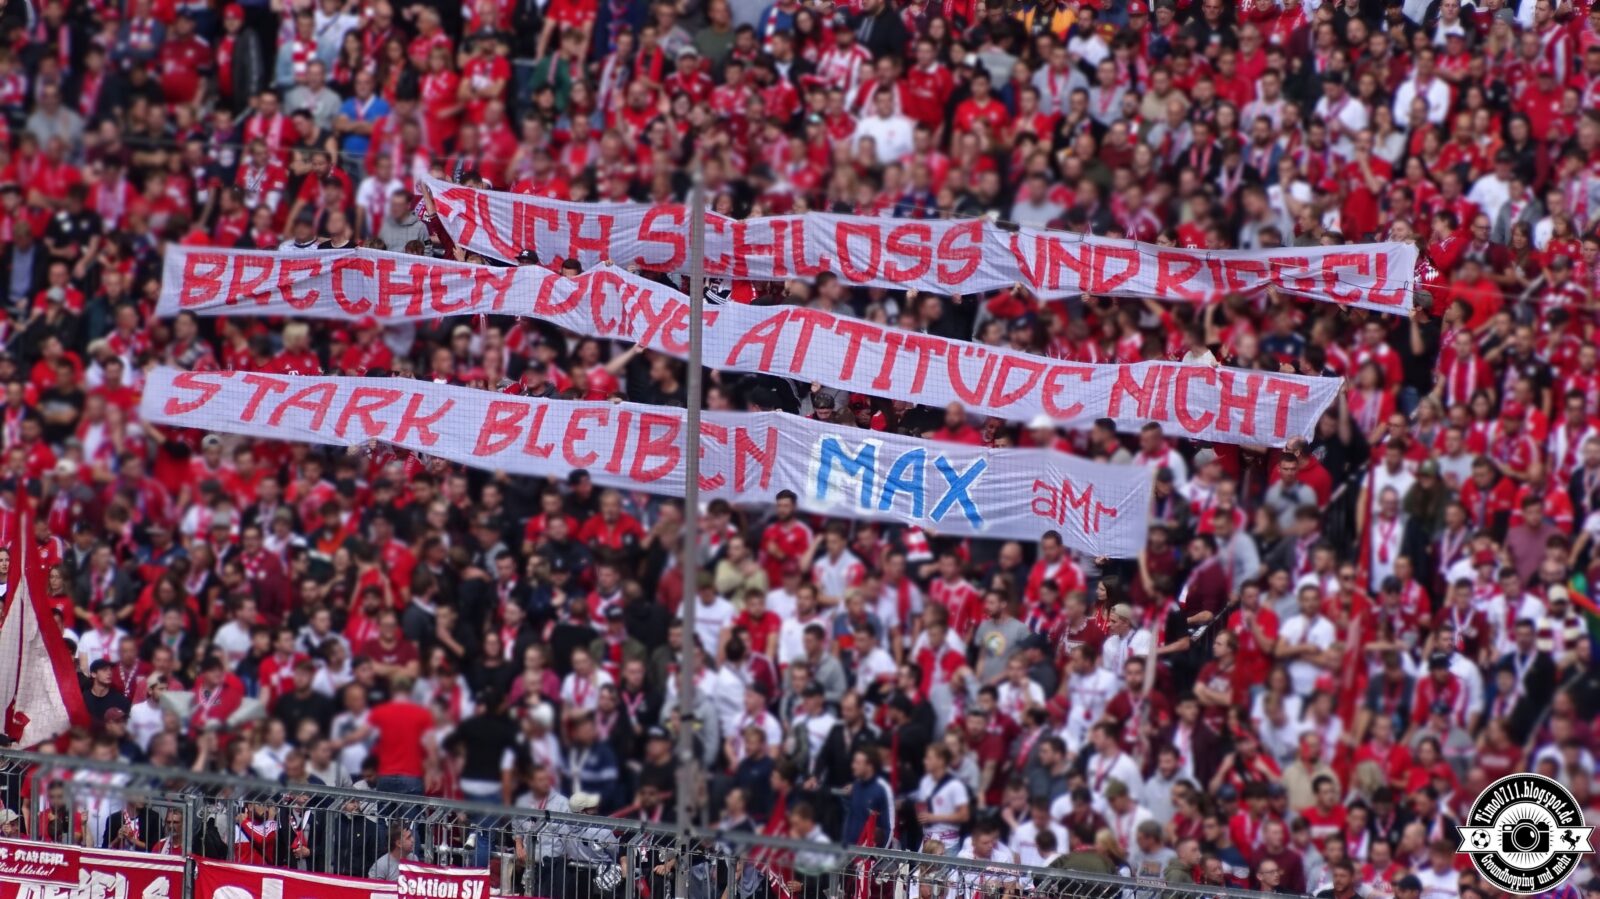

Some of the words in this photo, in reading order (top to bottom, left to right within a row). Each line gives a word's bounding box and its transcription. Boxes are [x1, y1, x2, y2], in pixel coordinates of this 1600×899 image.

[434, 187, 614, 272] AUCH
[634, 203, 984, 285] SCHLOSS
[179, 251, 518, 317] BRECHEN
[533, 270, 720, 354] DEINE
[724, 307, 1097, 420] ATTITÜDE
[1106, 364, 1311, 439] NICHT
[163, 370, 455, 446] STARK
[472, 399, 779, 494] BLEIBEN
[815, 436, 989, 530] MAX
[398, 874, 459, 898] Sektion
